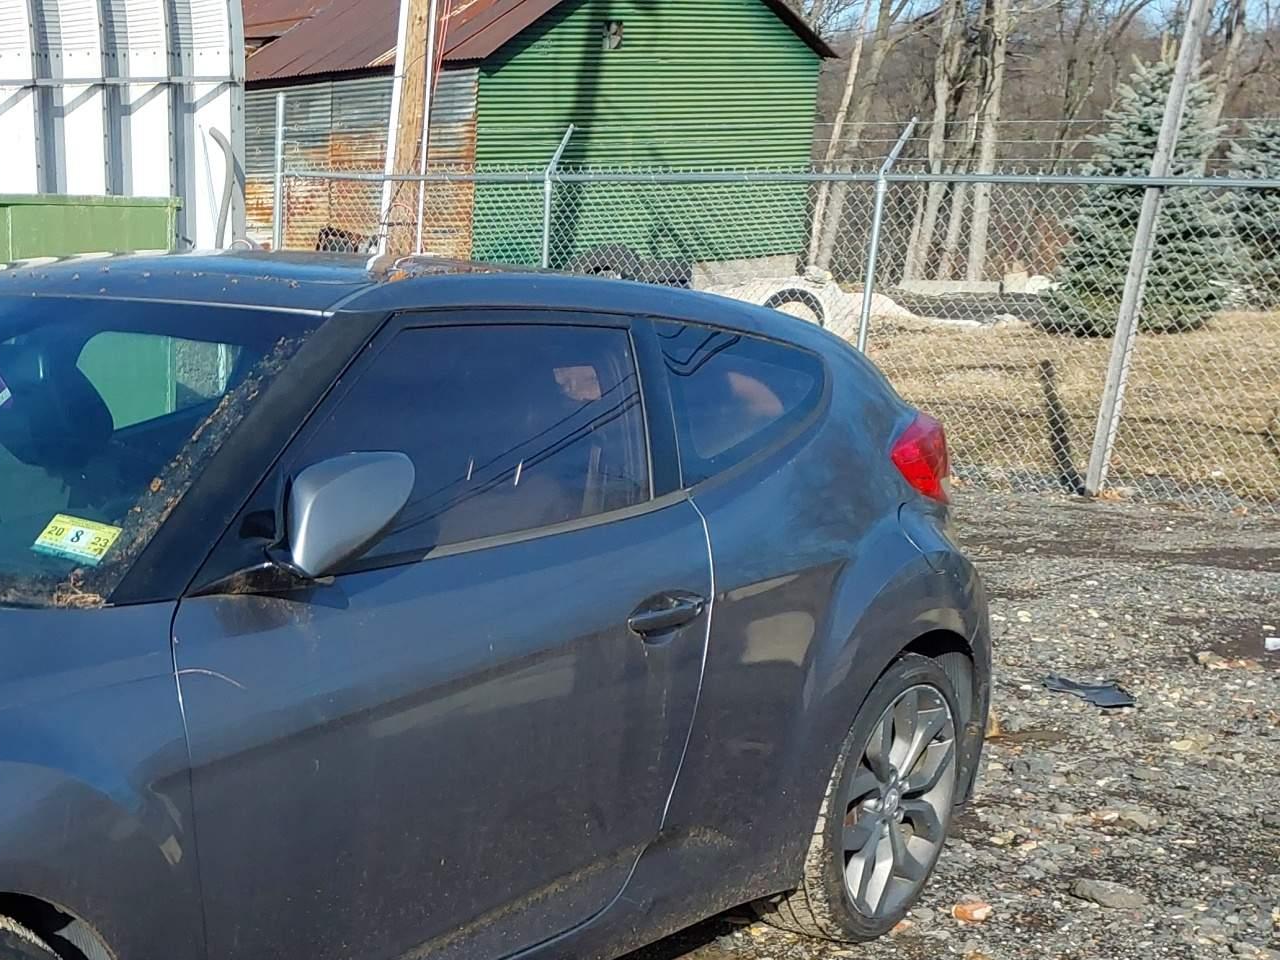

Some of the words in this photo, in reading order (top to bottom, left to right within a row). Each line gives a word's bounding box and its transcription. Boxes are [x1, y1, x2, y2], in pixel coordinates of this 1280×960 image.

[48, 525, 65, 537] 20
[70, 529, 84, 543] 8
[91, 536, 110, 548] 23
